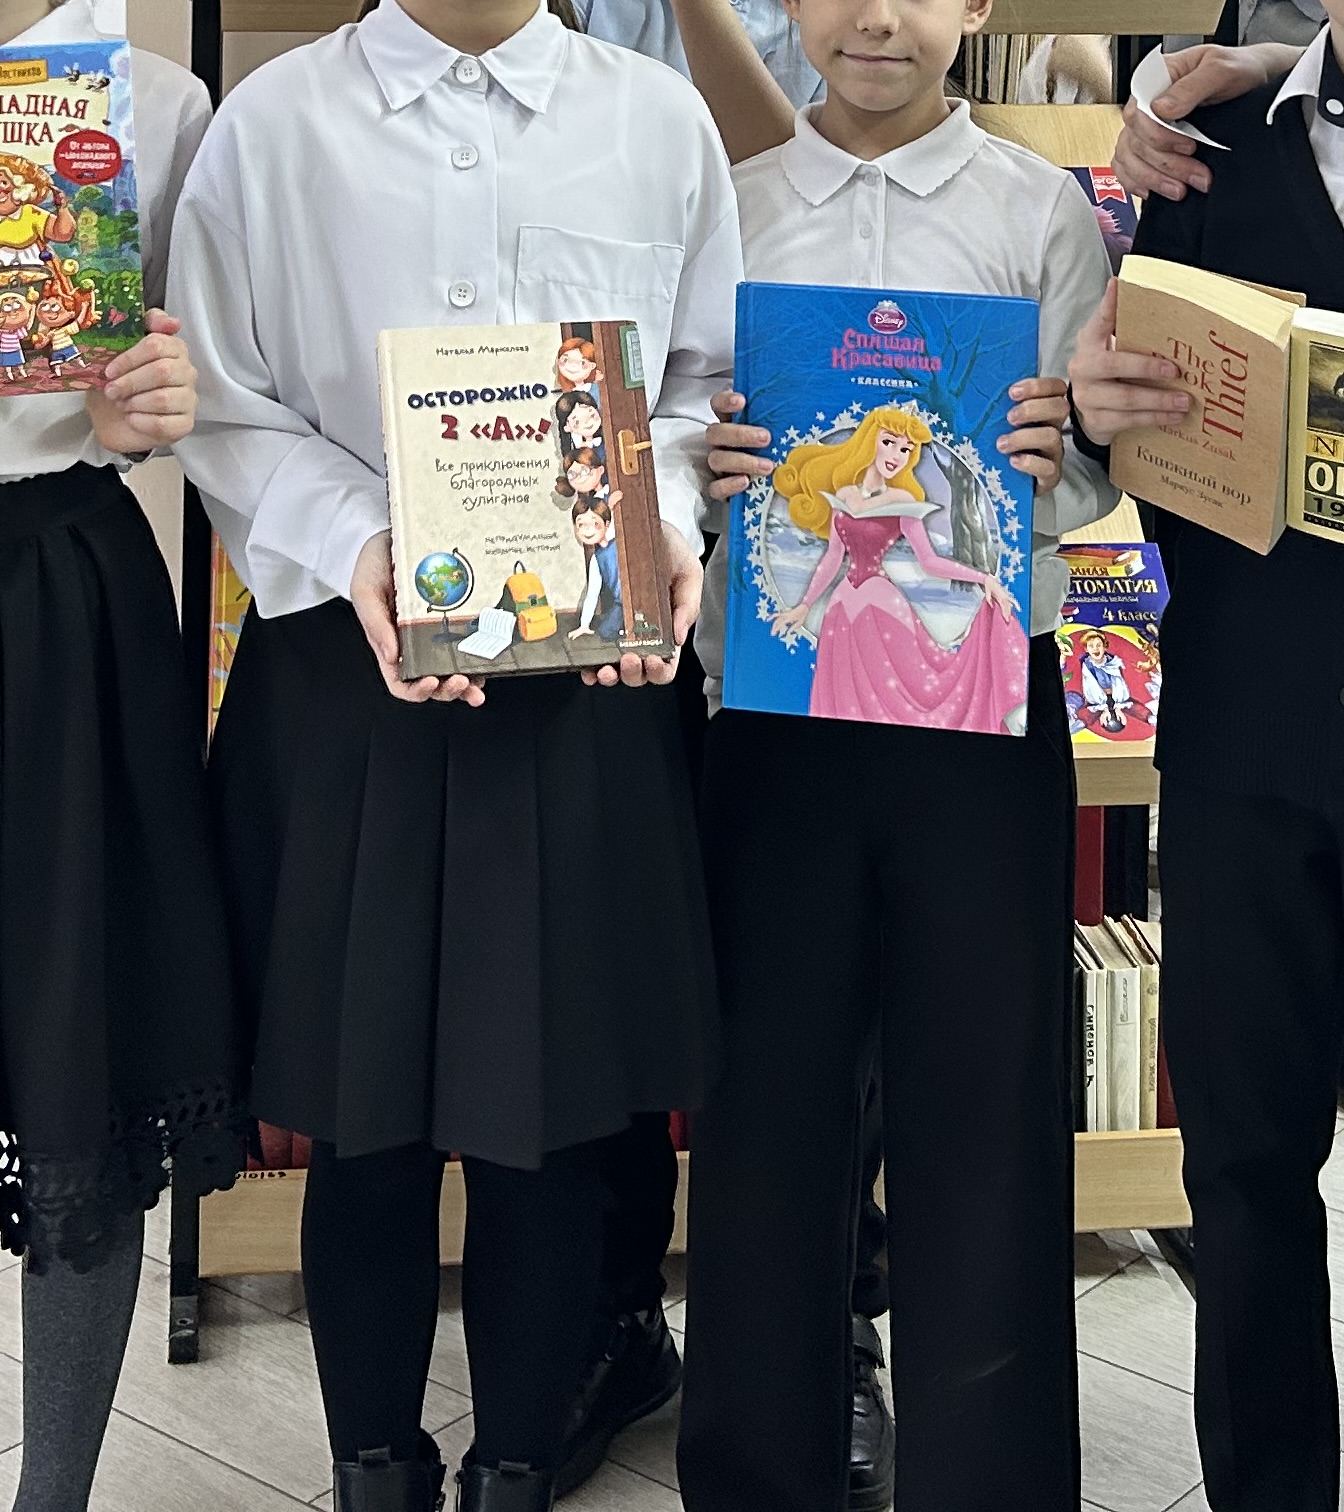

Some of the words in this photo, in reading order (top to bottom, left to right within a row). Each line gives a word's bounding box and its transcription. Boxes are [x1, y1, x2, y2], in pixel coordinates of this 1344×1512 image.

[1167, 336, 1216, 375] The
[407, 383, 549, 410] ОСТОРОЖНО
[1201, 328, 1249, 441] Thief
[441, 414, 459, 441] 2
[435, 457, 454, 472] Все
[460, 458, 551, 479] приключения
[1136, 444, 1218, 490] Книжный
[1221, 483, 1252, 507] вор
[450, 471, 540, 495] благородных
[462, 492, 531, 512] хулиганов
[1069, 578, 1159, 595] ТОМАТИЯ
[1102, 607, 1114, 622] 4
